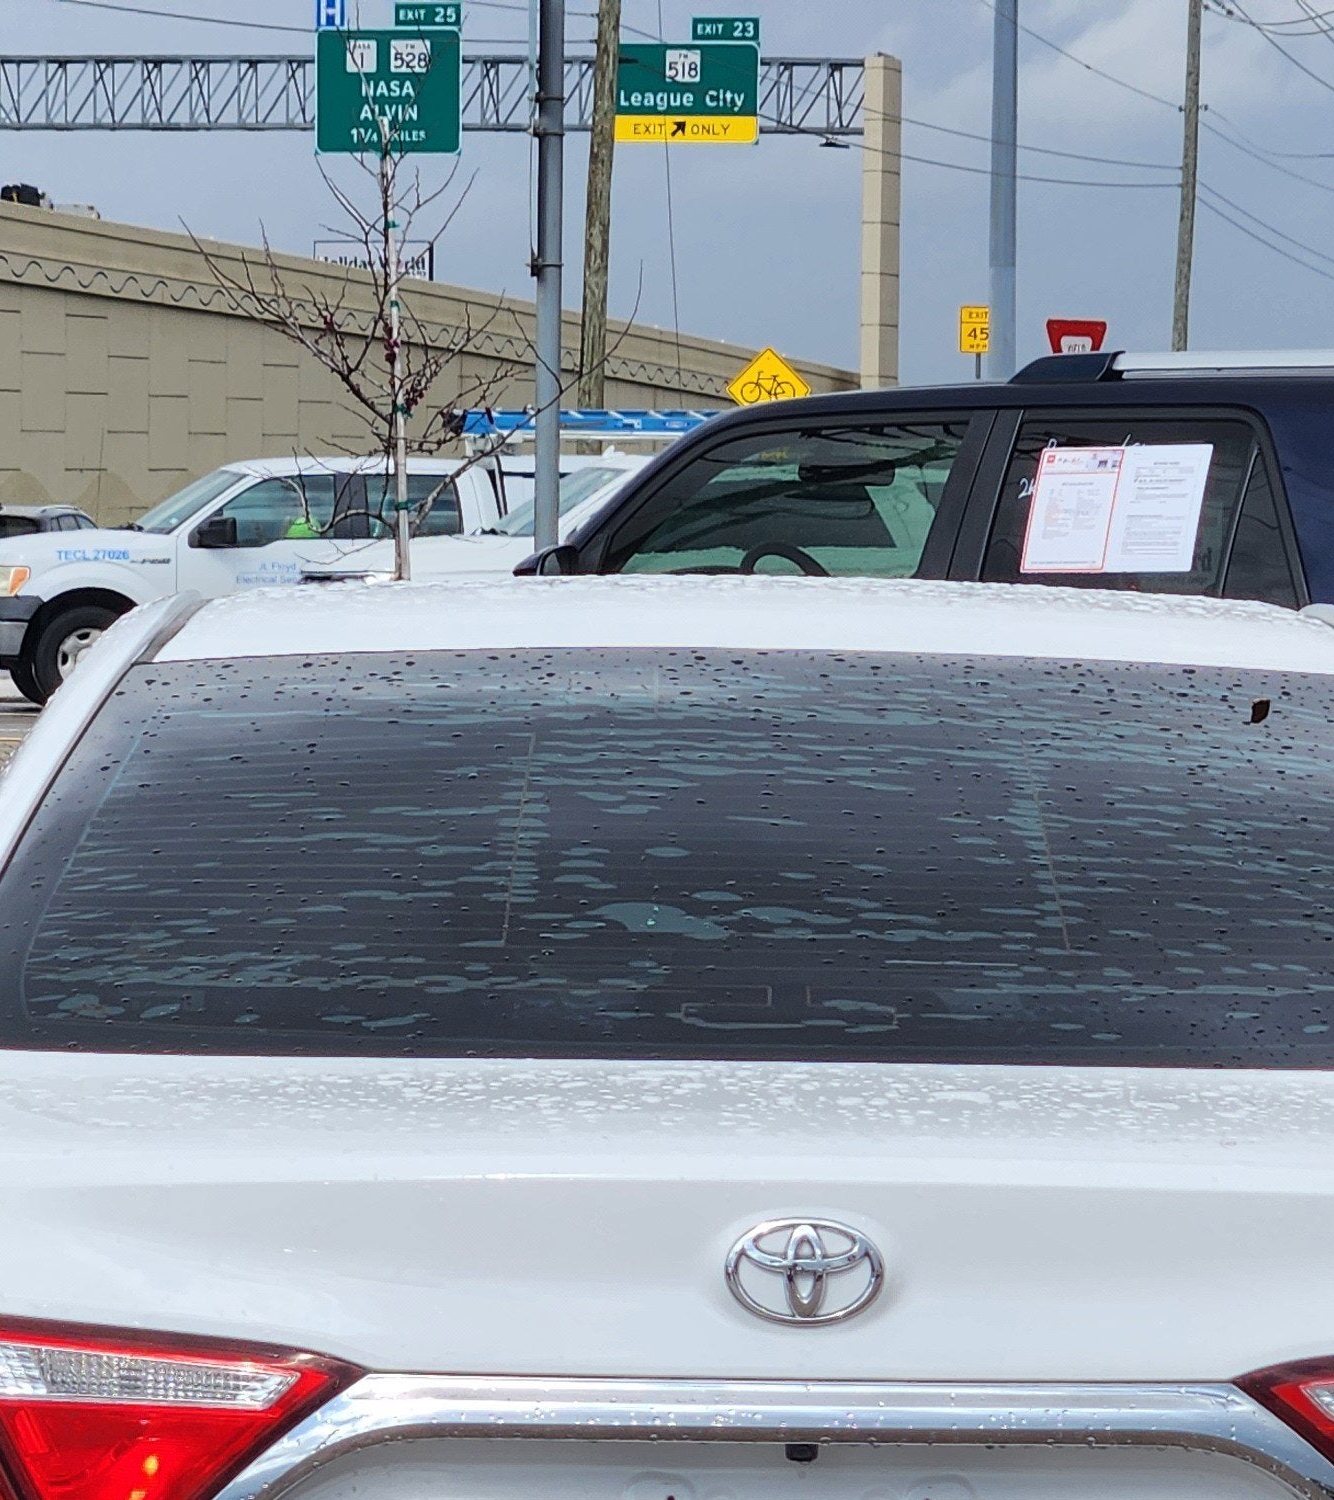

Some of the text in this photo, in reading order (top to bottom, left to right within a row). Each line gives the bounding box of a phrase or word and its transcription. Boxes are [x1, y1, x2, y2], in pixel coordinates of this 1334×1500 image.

[399, 6, 456, 23] EXIT 25
[697, 21, 755, 37] EXIT 23
[359, 52, 364, 69] 1
[393, 52, 429, 69] 528
[668, 61, 699, 79] 518
[361, 80, 416, 97] NASA
[620, 88, 745, 112] League City
[359, 104, 418, 122] ALVIN
[633, 123, 731, 136] EXIT ONLY
[968, 311, 988, 320] EXIT
[967, 327, 989, 341] 45
[57, 549, 91, 561] TECL
